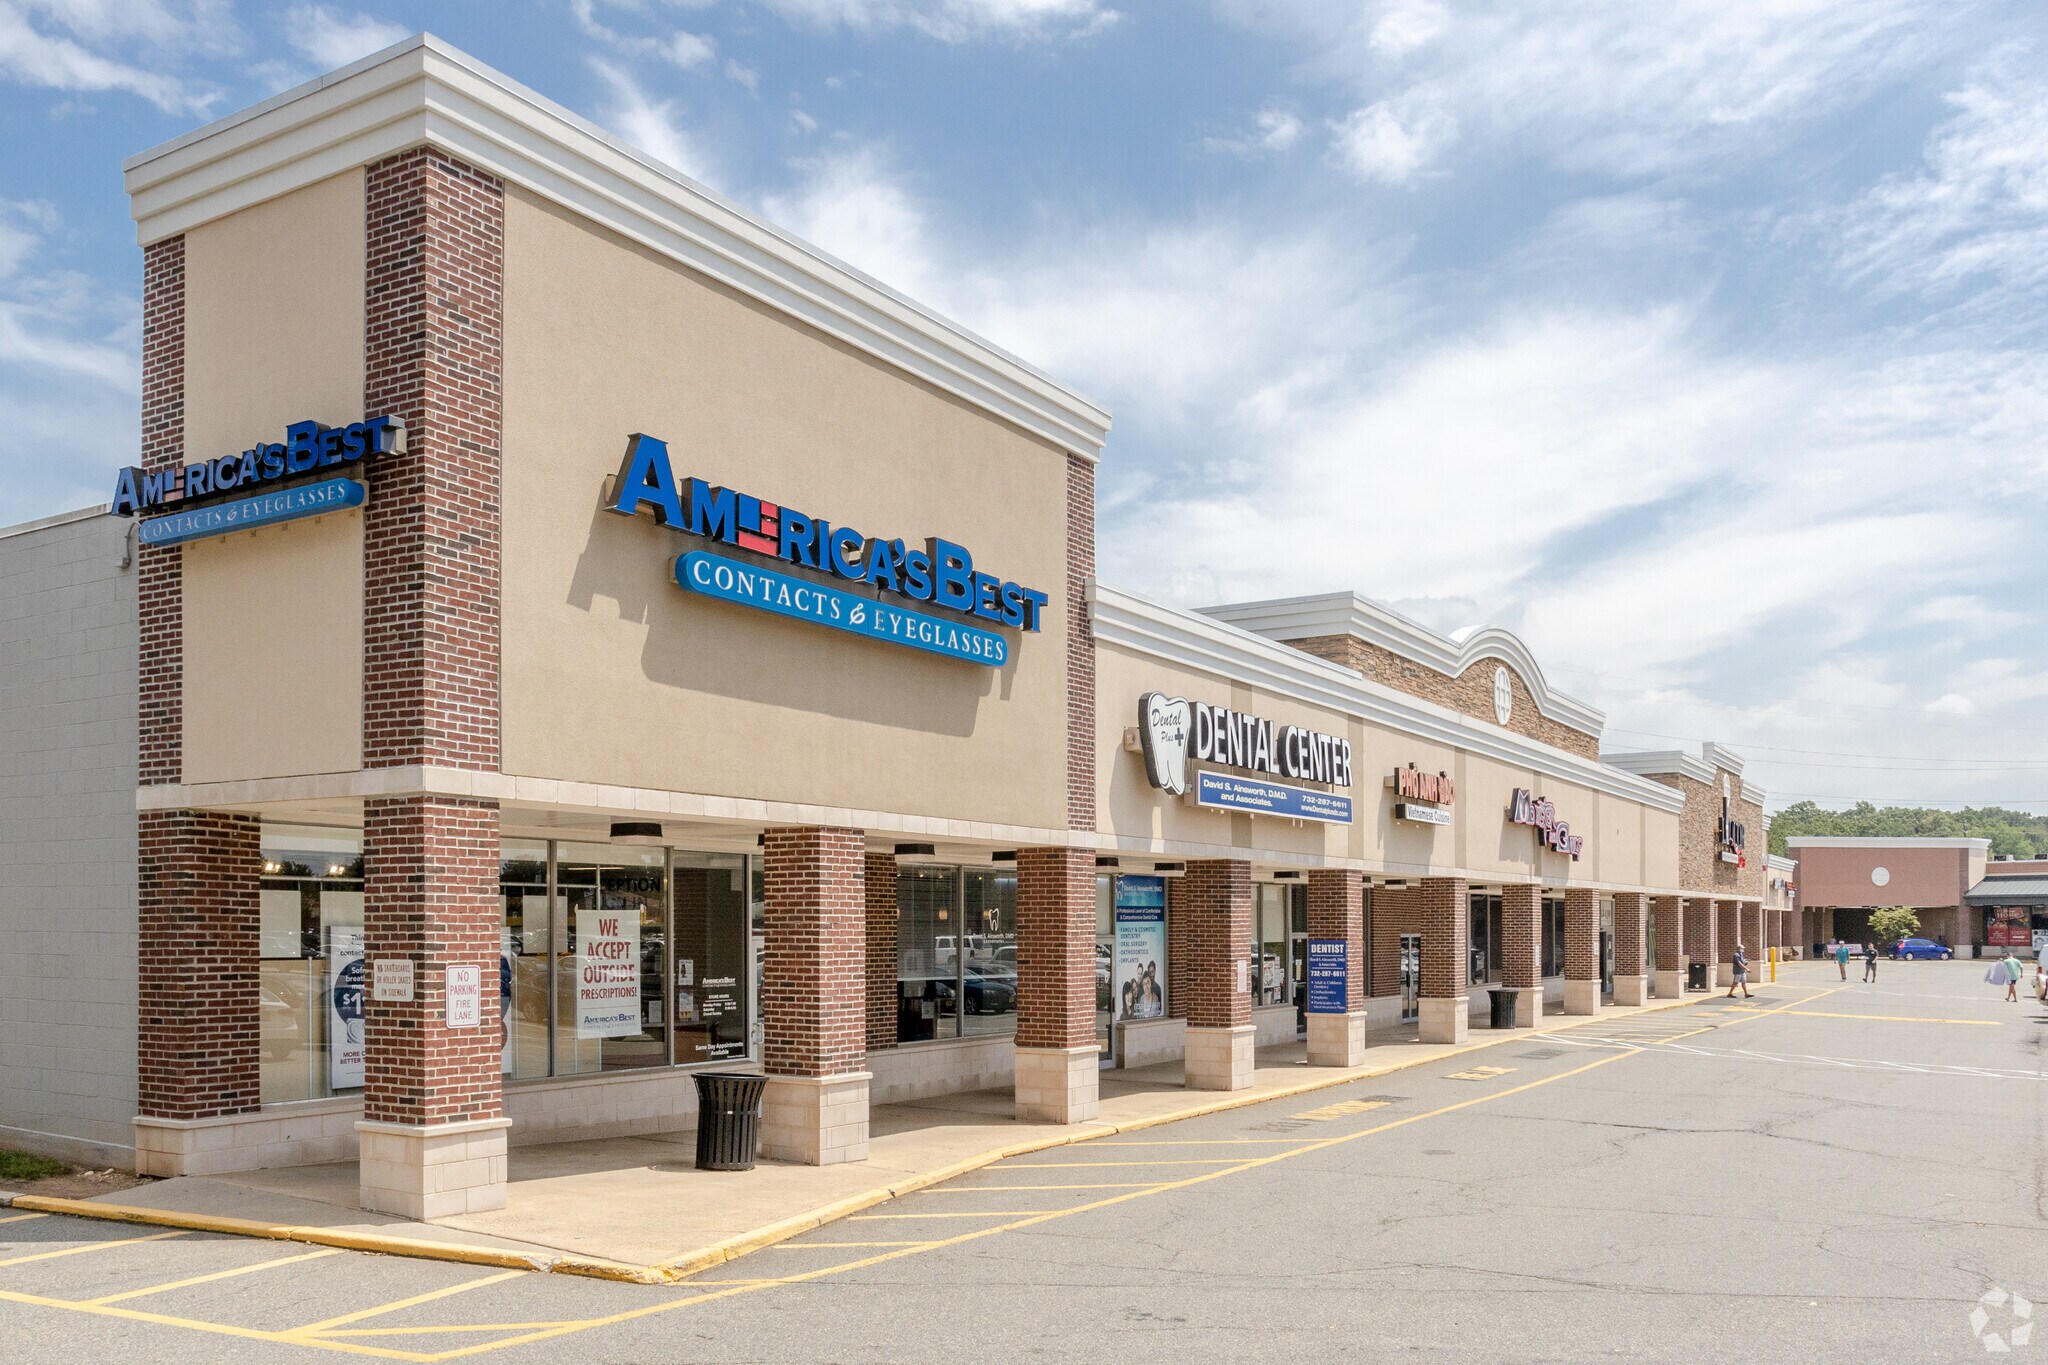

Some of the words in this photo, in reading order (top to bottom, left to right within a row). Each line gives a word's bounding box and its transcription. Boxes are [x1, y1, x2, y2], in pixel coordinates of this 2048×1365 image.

[142, 510, 222, 539] CONTACTS
[242, 483, 346, 519] EYEGLASSES
[693, 559, 841, 620] CONTACTS
[849, 602, 866, 626] &
[874, 609, 1005, 662] EYEGLASSES
[1151, 709, 1182, 727] Dental
[1196, 702, 1280, 774] DENTAL
[1285, 725, 1354, 787] CENTER
[1204, 779, 1223, 789] David
[1225, 782, 1231, 790] S.
[1233, 784, 1267, 797] Ainsworth,
[1221, 793, 1234, 801] and
[1408, 805, 1434, 821] Vietnamese
[1434, 811, 1450, 824] Cuisine
[599, 918, 619, 937] WE
[587, 942, 631, 960] ACCEPT
[1311, 944, 1344, 953] DENTIST
[457, 971, 470, 982] NO
[583, 964, 635, 984] OUTSIDE
[450, 984, 478, 996] PARKING
[581, 986, 637, 1000] PRESCRIPTIONS!
[456, 1000, 472, 1008] FIRE
[454, 1011, 472, 1021] LANE
